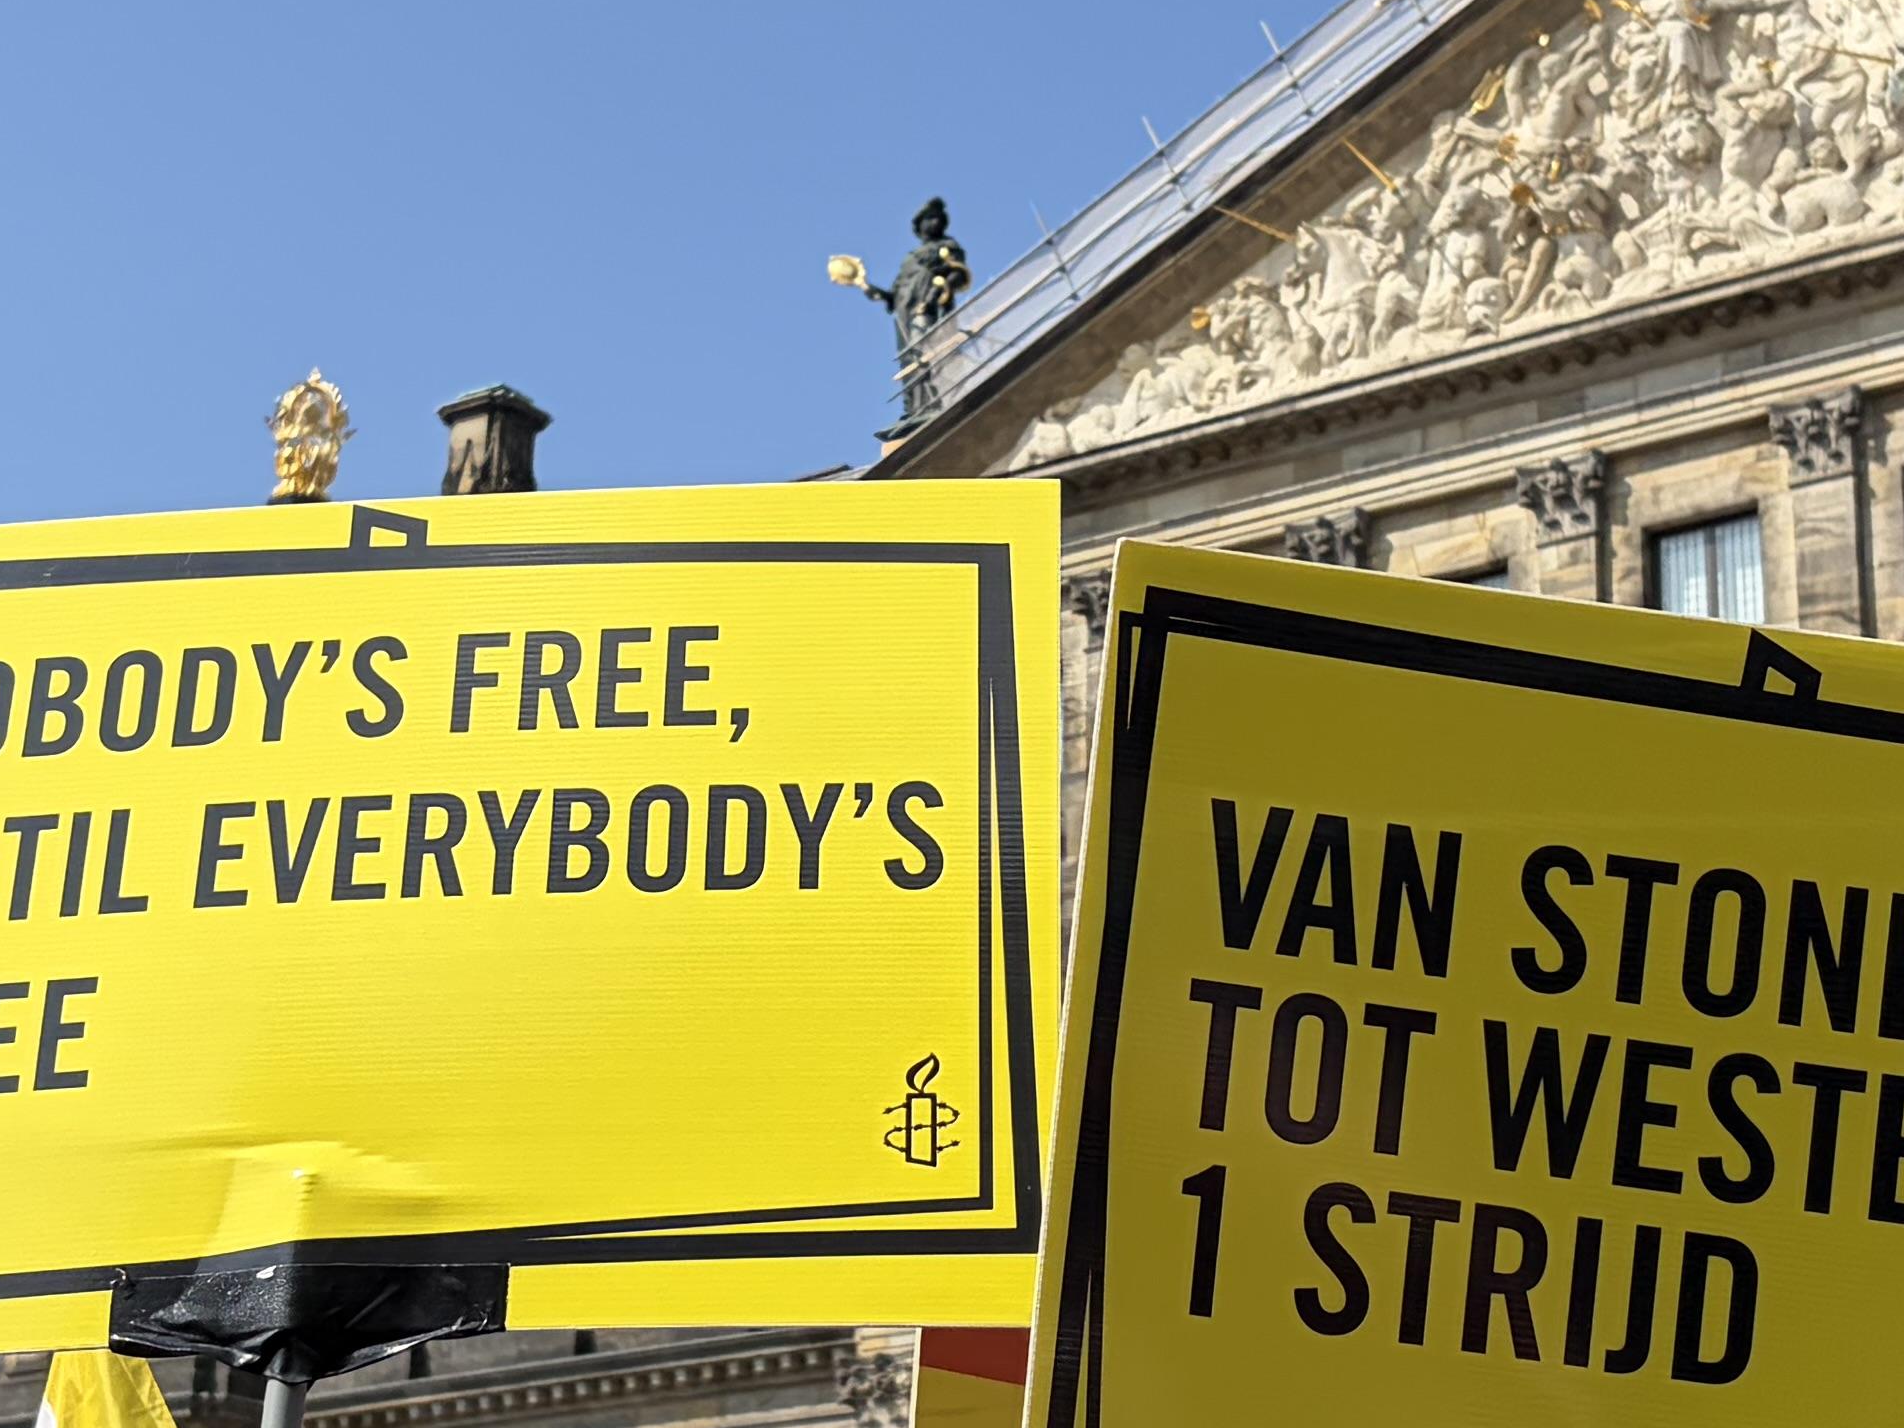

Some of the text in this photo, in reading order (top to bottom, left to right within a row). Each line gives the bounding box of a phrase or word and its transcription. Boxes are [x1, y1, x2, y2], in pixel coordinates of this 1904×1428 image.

[450, 626, 750, 743] FREE,
[193, 780, 944, 909] EVERYBODY’S
[1211, 798, 1463, 978] VAN
[1189, 977, 1437, 1156] TOT
[1181, 1164, 1759, 1386] 1 STRIJD
